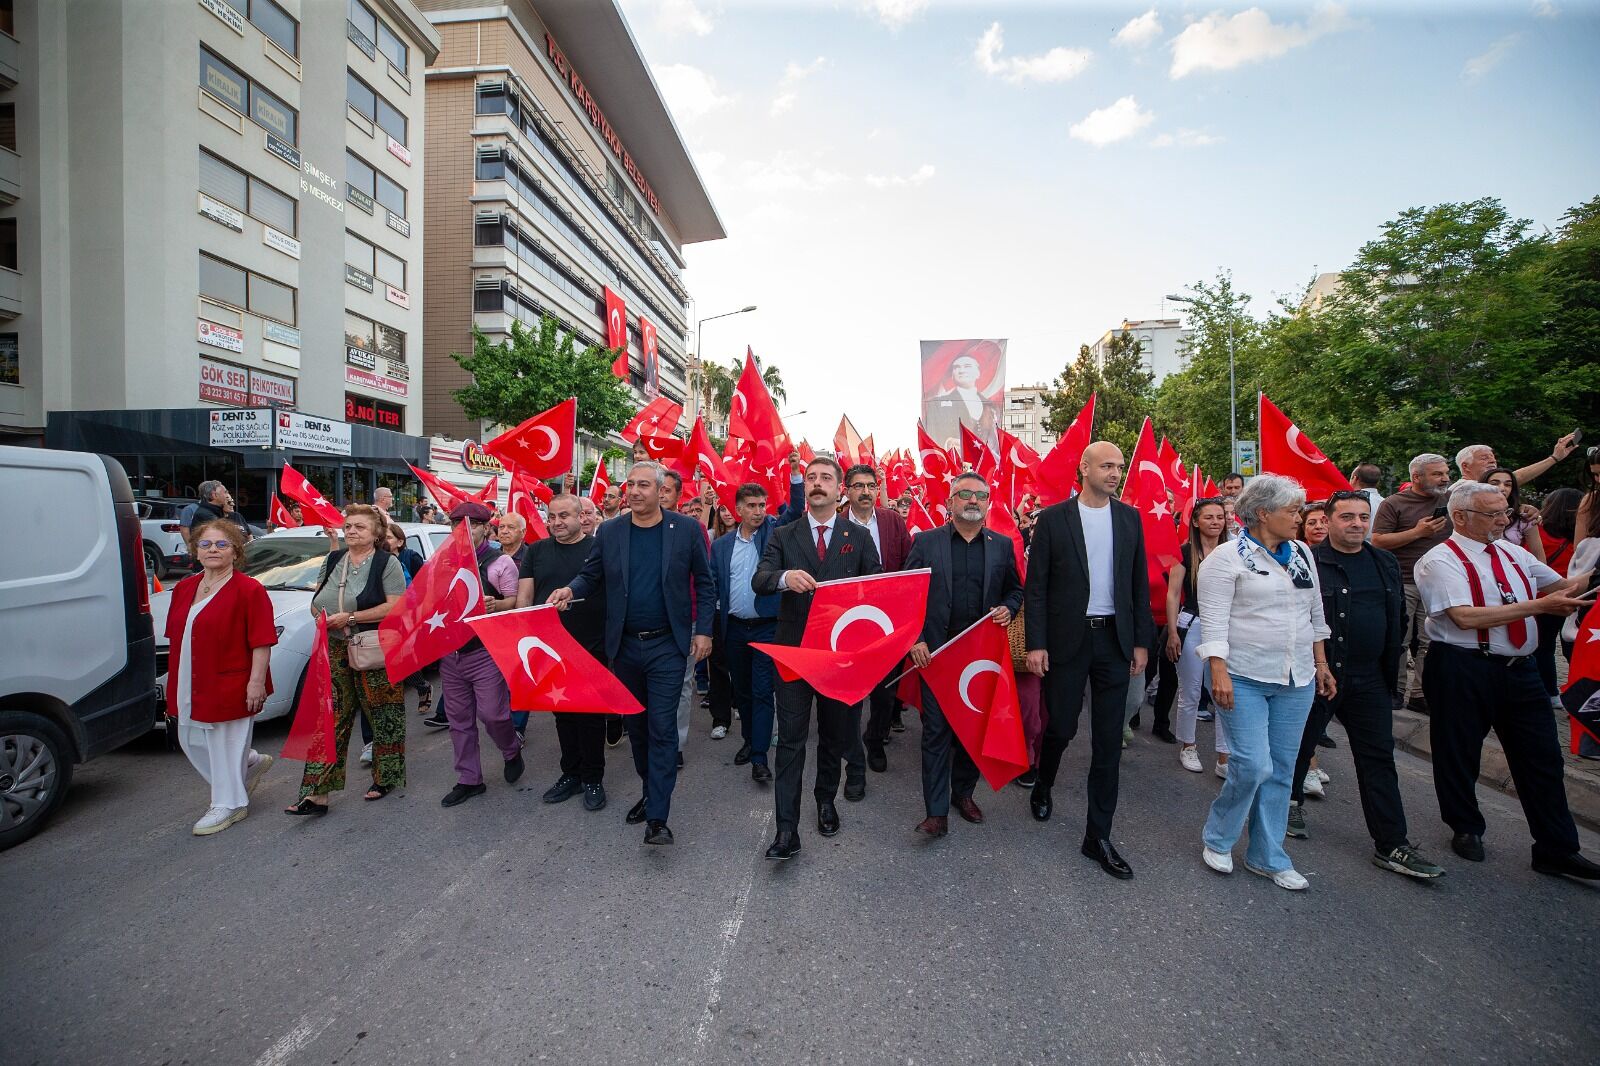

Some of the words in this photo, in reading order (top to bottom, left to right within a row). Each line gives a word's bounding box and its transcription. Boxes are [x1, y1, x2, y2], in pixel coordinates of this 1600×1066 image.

[569, 70, 621, 159] KARŞIYAKA
[623, 151, 661, 216] BELEDİYESİ
[304, 161, 337, 190] ŞİMŞEK
[309, 184, 344, 213] MERKEZİ
[201, 364, 224, 384] GÖK
[226, 371, 246, 389] SER
[252, 376, 292, 399] PSİKOTEKNİK
[212, 424, 226, 432] AĞIZ
[222, 412, 244, 421] DENT
[245, 412, 256, 420] 35
[304, 420, 322, 432] DENT
[322, 424, 331, 432] 35
[279, 428, 292, 436] AĞIZ
